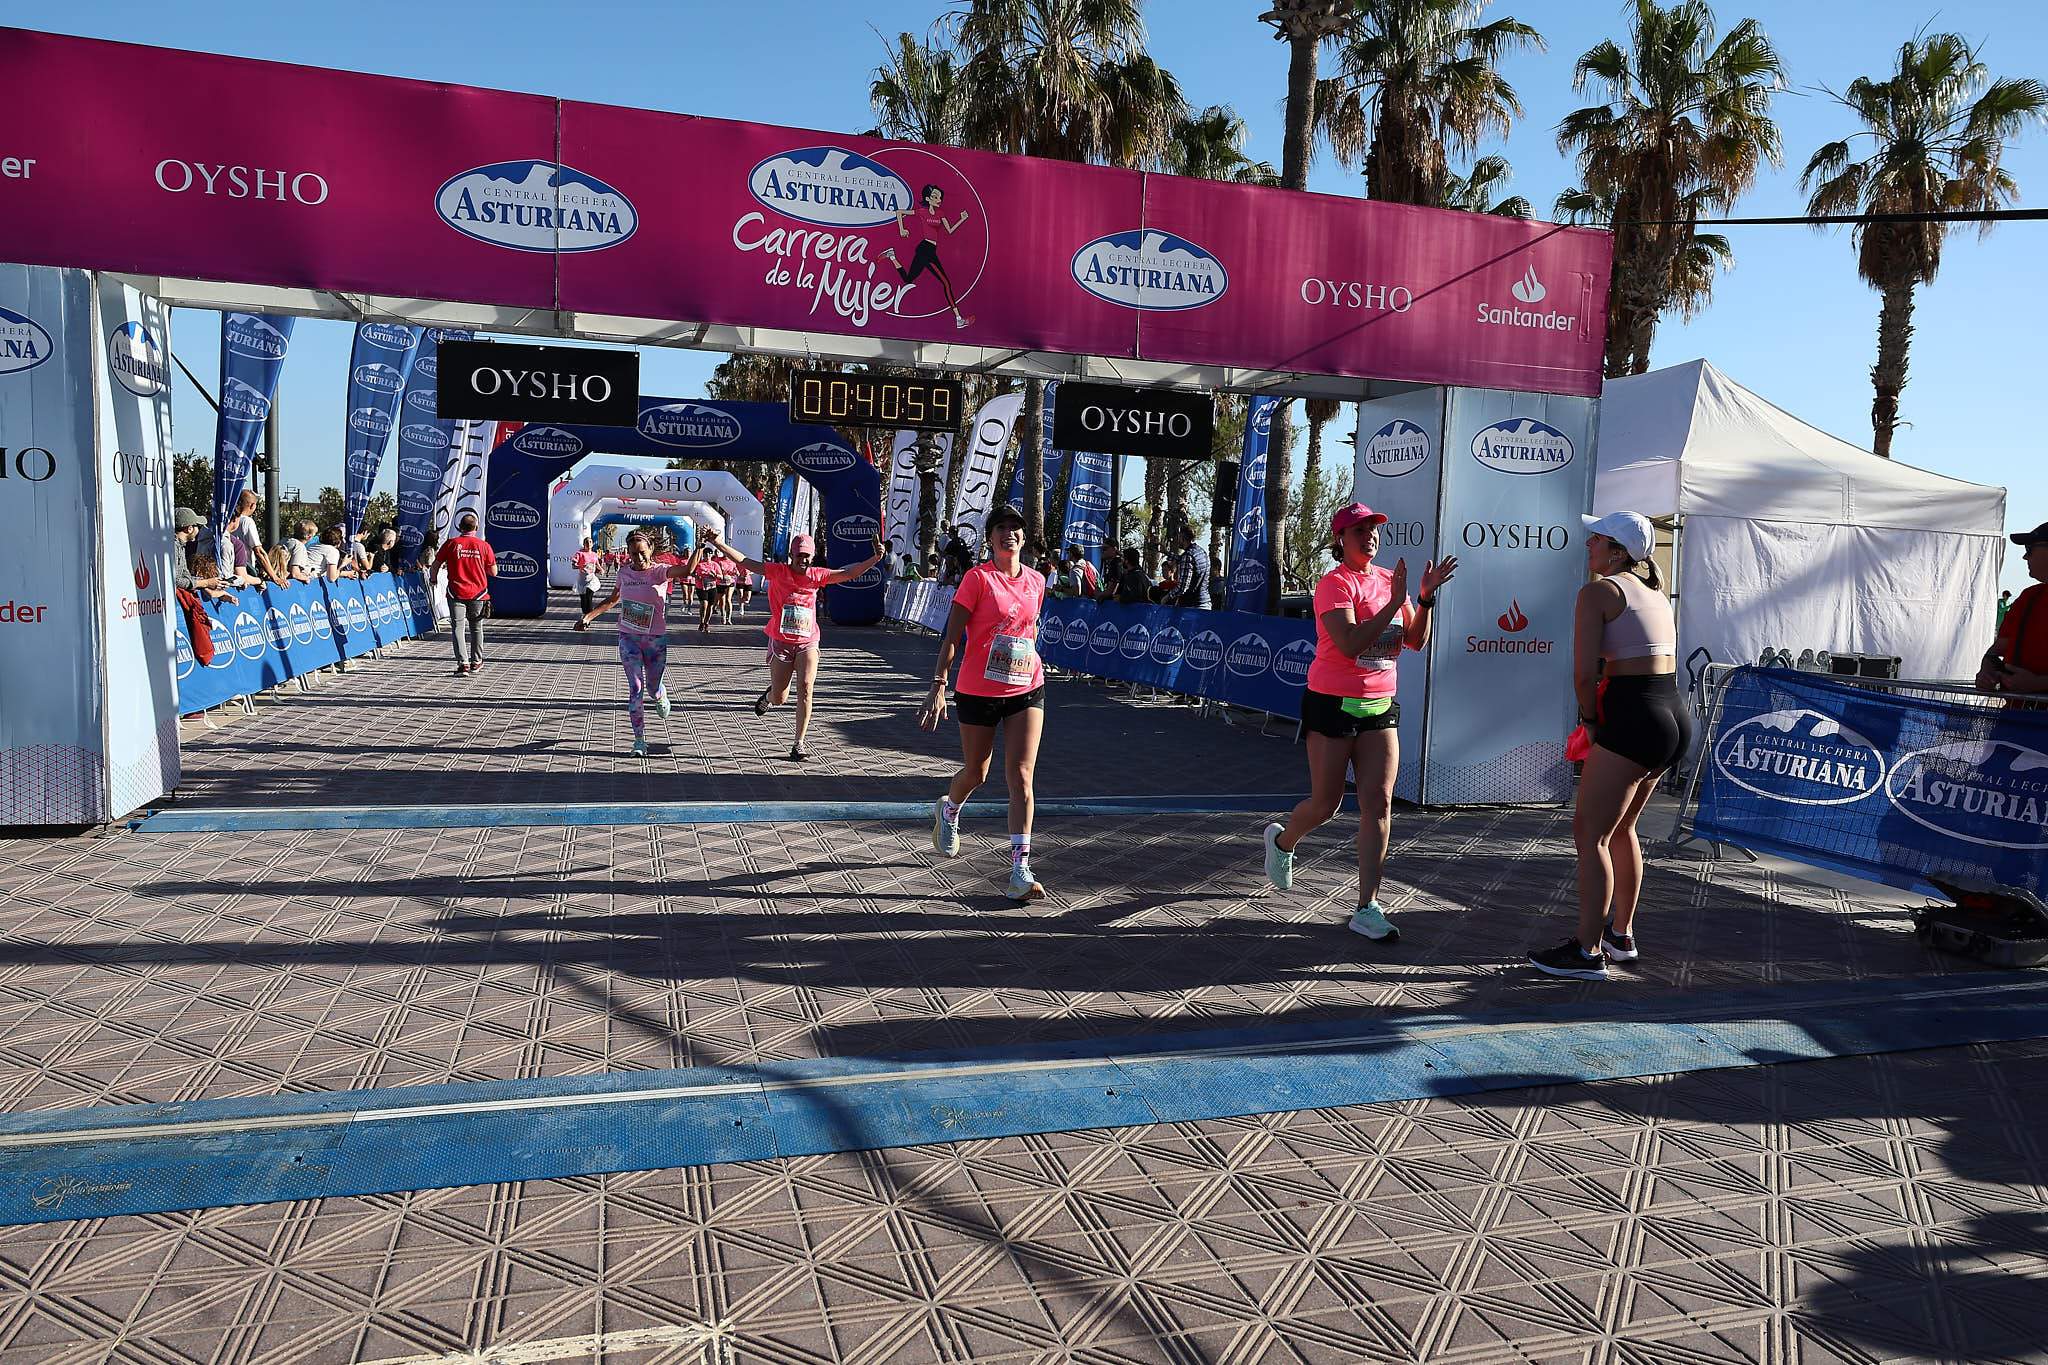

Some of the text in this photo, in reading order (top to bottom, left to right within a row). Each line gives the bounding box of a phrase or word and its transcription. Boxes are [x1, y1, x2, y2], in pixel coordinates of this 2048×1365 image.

[154, 159, 329, 206] OYSHO
[483, 186, 548, 202] CENTRAL
[761, 168, 900, 212] ASTURIANA
[788, 169, 897, 190] CENTRAL LECHERA
[452, 186, 623, 235] ASTURIANA
[733, 211, 869, 265] Carrera
[1083, 252, 1216, 295] ASTURIANA
[765, 258, 916, 328] de la Mujer
[1300, 278, 1413, 314] OYSHO
[1476, 302, 1576, 332] Santander
[113, 340, 165, 385] ASTURIANA
[471, 366, 612, 403] OYSHO
[803, 379, 950, 421] 00:40:59
[643, 415, 734, 438] ASTURIANA
[1081, 405, 1192, 438] OYSHO
[517, 437, 578, 453] ASTURIANA
[797, 453, 852, 465] ASTURIANA
[1368, 444, 1425, 465] ASTURIANA
[1477, 436, 1566, 463] ASTURIANA
[113, 450, 167, 489] OYSHO
[618, 473, 702, 494] OYSHO
[956, 418, 1006, 550] OYSHO
[489, 509, 537, 523] ASTURIANA
[1463, 521, 1569, 551] OYSHO
[1227, 647, 1267, 668] ASTURIANA
[1466, 636, 1554, 654] Santander
[1724, 732, 1867, 791] ASTURIANA
[1754, 734, 1869, 762] CENTRAL LECHERA
